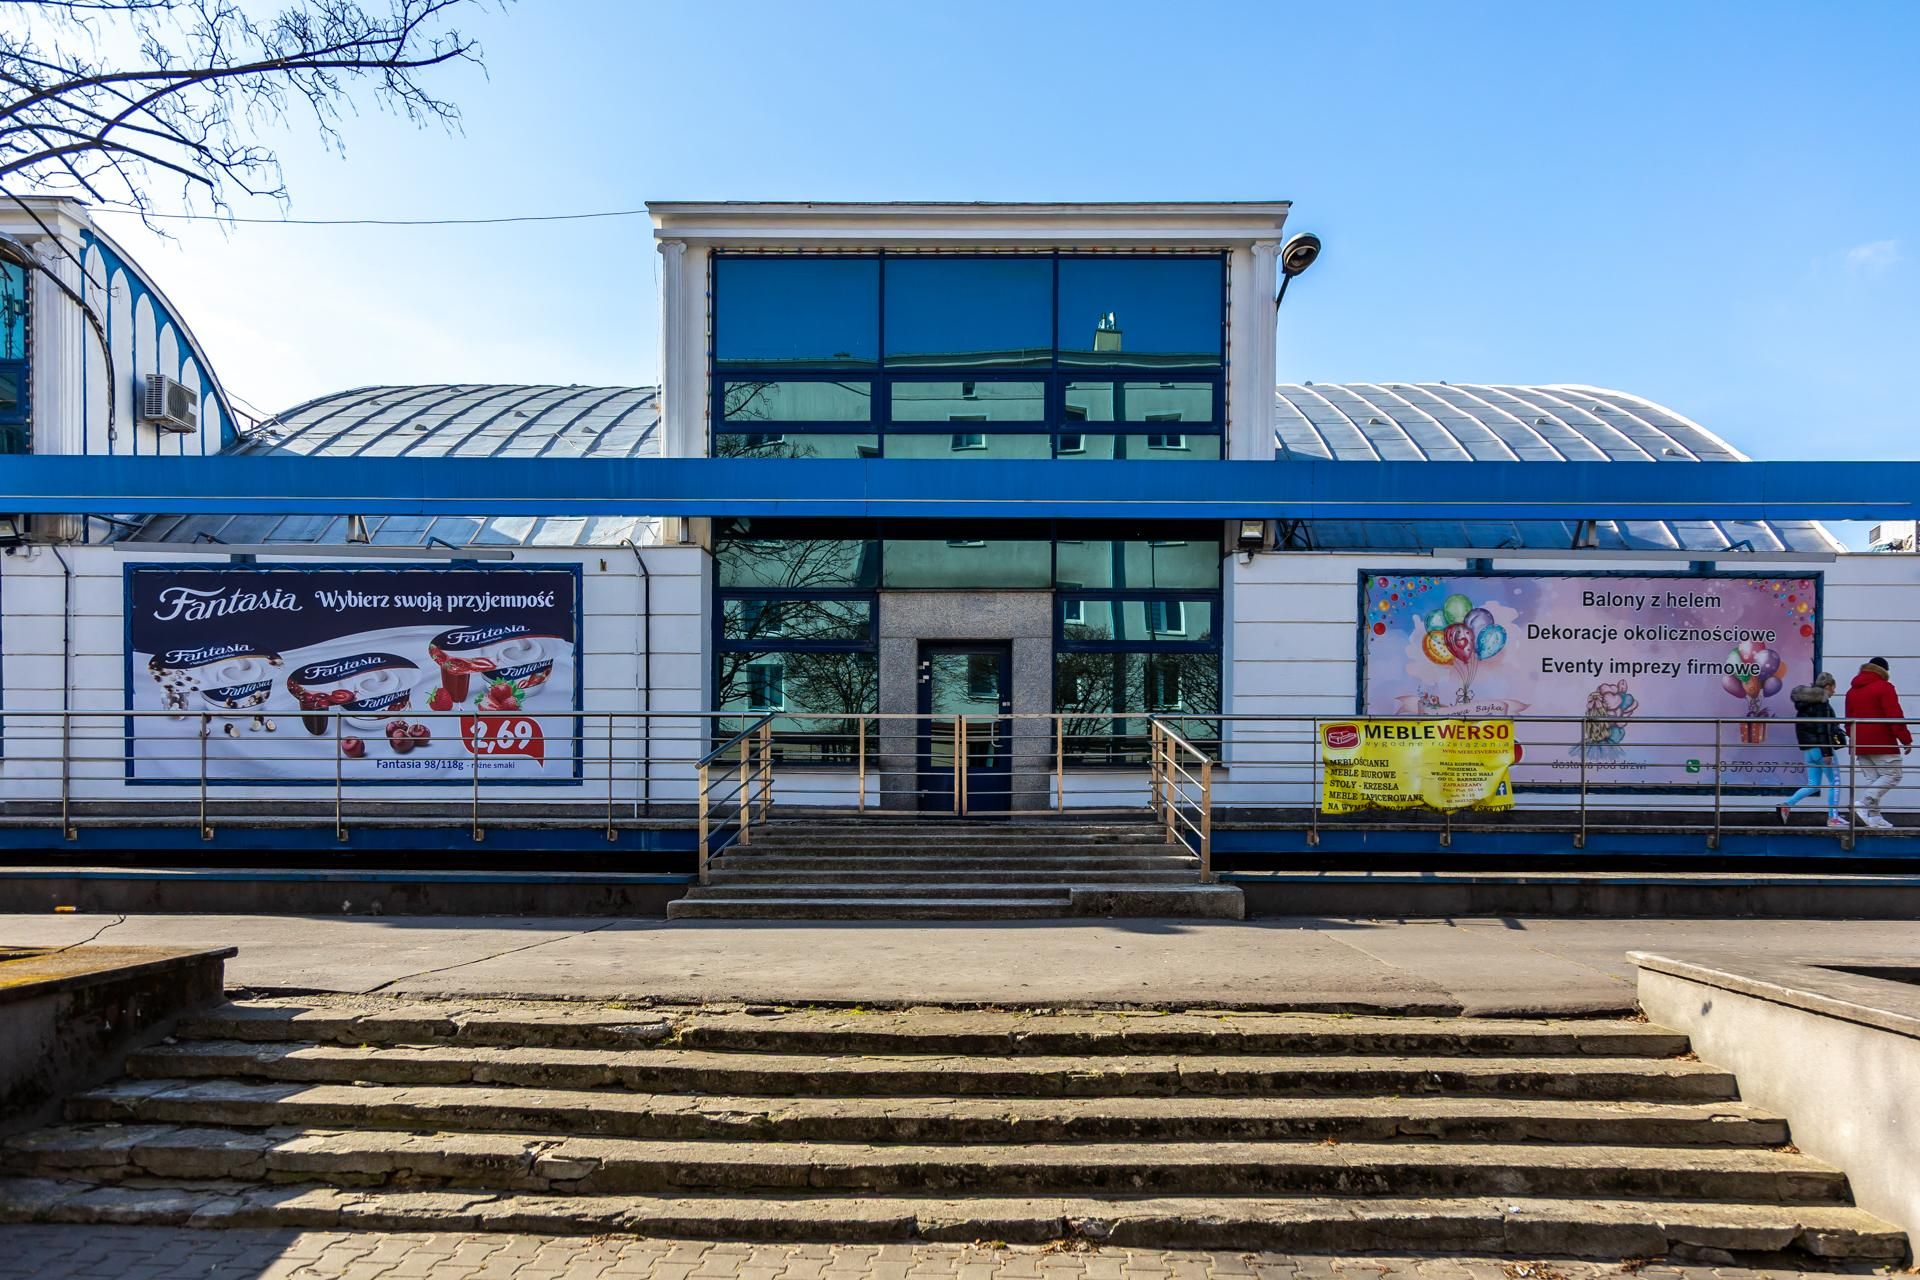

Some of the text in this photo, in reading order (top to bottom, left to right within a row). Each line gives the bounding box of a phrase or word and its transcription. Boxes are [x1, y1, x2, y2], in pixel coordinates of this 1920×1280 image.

[153, 586, 303, 621] Fantasia
[315, 589, 555, 612] Wybierz swoją przyjemność
[1582, 591, 1721, 610] Balony z helem
[447, 625, 531, 645] Fantasia
[1527, 624, 1776, 643] Dekoracje okolicznościowe
[165, 643, 255, 664] Fantasia
[304, 656, 387, 680] Fantasia
[1542, 657, 1760, 677] Eventy imprezy firmowe
[469, 719, 533, 753] 2,69
[1364, 724, 1509, 740] MEBLEWERSO
[376, 760, 421, 769] Fantasia
[424, 760, 464, 770] 98/118g
[471, 761, 492, 769] rżne
[493, 761, 515, 769] smaki
[1329, 757, 1389, 768] MEBLOŚCIANKI
[1596, 760, 1616, 772] pod
[1706, 760, 1726, 773] +8
[1330, 768, 1359, 777] MEBLE
[1361, 769, 1396, 779] BIUROWE
[1329, 790, 1358, 800] MEBLE
[1363, 782, 1399, 790] KRZESŁA
